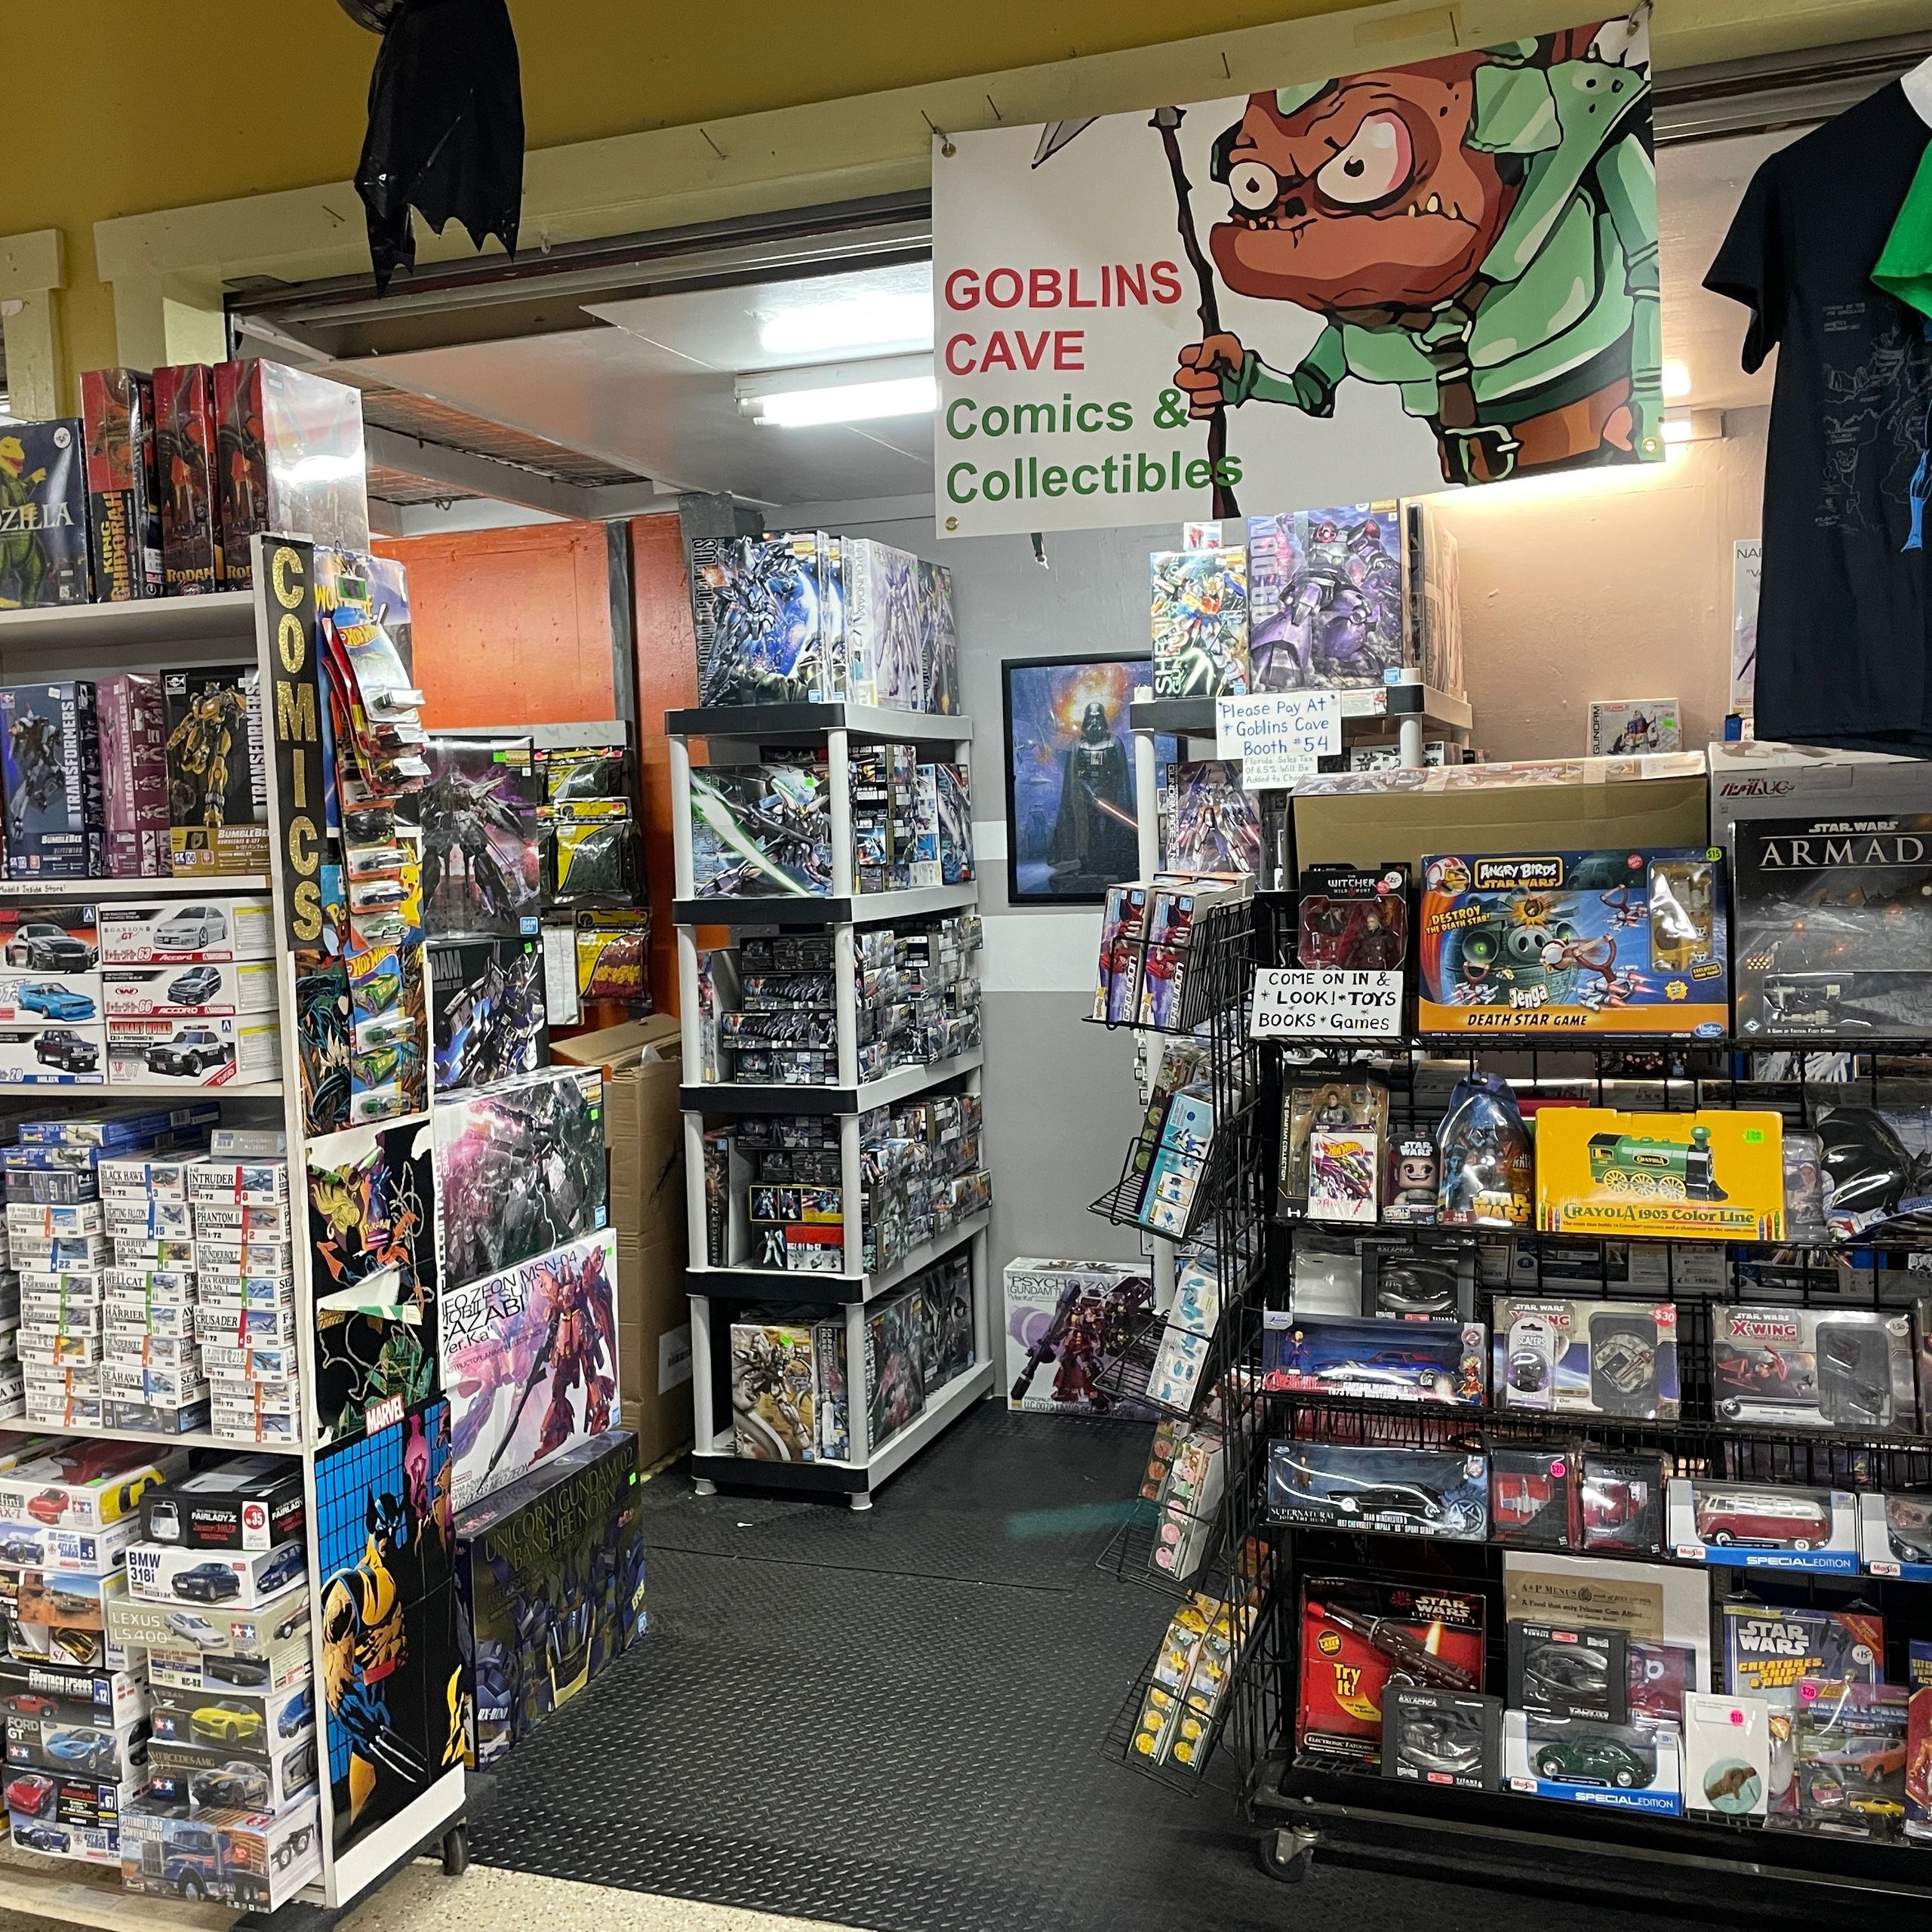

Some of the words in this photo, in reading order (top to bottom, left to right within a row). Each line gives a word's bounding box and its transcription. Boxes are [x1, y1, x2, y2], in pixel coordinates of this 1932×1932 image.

[945, 261, 1183, 310] GOBLINS
[946, 331, 1084, 375] CAVE
[946, 393, 1133, 439] Comics
[1153, 389, 1189, 429] &
[947, 451, 1244, 503] Collectibles
[102, 521, 113, 574] KING
[103, 491, 130, 601] GHIDORAH
[166, 565, 214, 583] RODAN
[1223, 703, 1269, 718] Please
[1278, 701, 1301, 716] Pay
[1307, 697, 1326, 712] At
[1237, 720, 1288, 737] Goblins
[1296, 717, 1328, 731] Cave
[246, 684, 267, 805] TRANSFORMERS
[272, 546, 322, 941] COMICS
[1244, 739, 1287, 755] Booth
[62, 701, 81, 813] TRANSFORMERS
[119, 695, 134, 810] TRANSFORMERS
[1246, 757, 1272, 765] Florida
[1247, 775, 1269, 783] Added
[1808, 823, 1853, 833] STAR
[1853, 821, 1899, 832] WARS
[42, 834, 82, 844] BUMBLEBEE
[1708, 849, 1721, 859] $15
[1481, 863, 1518, 879] ANGRY
[1520, 863, 1557, 878] BIRDS
[1327, 878, 1375, 888] WITCHER
[1481, 879, 1514, 888] STAR
[1517, 878, 1557, 888] WARS
[1431, 905, 1481, 926] DESTROY
[1426, 926, 1440, 935] THE
[1441, 920, 1466, 931] DEATH
[1468, 913, 1491, 925] STAR!
[122, 932, 133, 940] GT
[137, 947, 152, 960] 63
[353, 955, 371, 977] HOT
[1269, 973, 1315, 985] COME
[1323, 973, 1344, 984] ON
[1352, 973, 1368, 985] IN
[1377, 972, 1391, 986] &
[1123, 955, 1137, 1021] GROUDON
[1169, 962, 1185, 1028] GROUDON
[1277, 991, 1335, 1005] LOOK!
[1348, 992, 1396, 1006] TOYS
[1511, 985, 1548, 1008] Jenga
[139, 999, 152, 1012] 66
[1259, 1013, 1315, 1027] BOOKS
[1331, 1014, 1389, 1029] Games
[1468, 1014, 1512, 1026] DEATH
[1514, 1014, 1549, 1026] STAR
[1554, 1015, 1588, 1026] GAME
[146, 1021, 172, 1035] WORKS
[10, 1069, 23, 1081] 20
[125, 1063, 138, 1077] 07
[1329, 1145, 1340, 1155] HOT
[1400, 1146, 1433, 1156] WARS
[1404, 1141, 1432, 1150] STAR
[1637, 1156, 1664, 1164] CRAYOLA
[101, 1171, 122, 1180] BLACK
[124, 1171, 144, 1182] HAWK
[189, 1174, 234, 1184] INTRUDER
[1473, 1191, 1531, 1208] STAR
[106, 1209, 127, 1218] FIGHTING
[128, 1209, 146, 1218] FALCON
[197, 1212, 233, 1223] PHANTOM
[1473, 1204, 1532, 1222] WARS
[1564, 1202, 1636, 1221] CRAYOLA
[1638, 1208, 1669, 1220] 1903
[1672, 1210, 1717, 1221] Color
[1720, 1211, 1755, 1223] Line
[249, 1231, 255, 1239] 2
[59, 1260, 70, 1269] 22
[106, 1275, 143, 1287] HELLCAT
[213, 1277, 241, 1285] HARRIER
[470, 1273, 515, 1300] ZEON
[520, 1250, 578, 1281] MSN-04
[106, 1308, 144, 1320] HARRIER
[196, 1314, 238, 1327] CRUSADER
[1655, 1310, 1675, 1322] $30
[1763, 1313, 1789, 1321] WARS
[1730, 1320, 1797, 1337] X-WING
[246, 1335, 252, 1343] 9
[102, 1371, 143, 1385] SEAHAWK
[367, 1399, 404, 1430] MARVEL
[1552, 1465, 1564, 1475] $20
[485, 1497, 555, 1562] UNICORN
[558, 1459, 618, 1513] GUNDAM
[620, 1447, 634, 1472] 02
[191, 1512, 228, 1522] FAIRLADY
[228, 1515, 237, 1523] Z
[1271, 1507, 1334, 1520] SUPERNATURAL
[514, 1512, 574, 1572] BANSHEE
[578, 1488, 616, 1527] NORN
[129, 1552, 161, 1566] BMW
[1679, 1547, 1703, 1558] Maisto
[1746, 1556, 1814, 1567] SPECIAL
[1814, 1558, 1850, 1568] EDITION
[131, 1567, 155, 1583] 318i
[1873, 1564, 1898, 1574] Maisto
[1546, 1586, 1577, 1597] MENUS
[1416, 1595, 1470, 1610] STAR
[1417, 1604, 1470, 1617] WARS
[112, 1611, 161, 1627] LEXUS
[115, 1629, 168, 1644] LS400
[1739, 1621, 1810, 1641] STAR
[1319, 1638, 1340, 1649] LASER
[1739, 1635, 1810, 1656] WARS
[1334, 1663, 1361, 1684] Try
[1760, 1666, 1806, 1678] SHIPS
[29, 1672, 65, 1686] COUNTACH
[66, 1678, 93, 1689] LP500S
[1337, 1679, 1356, 1697] It!
[1802, 1687, 1815, 1697] $20
[1398, 1697, 1438, 1707] GALACTICA
[7, 1715, 38, 1730] FORD
[1730, 1713, 1743, 1724] $10
[8, 1727, 24, 1740] GT
[1308, 1737, 1344, 1747] ELECTRONIC
[151, 1751, 215, 1767] MERCEDES-AMG
[1512, 1780, 1535, 1791] Maisto
[1575, 1792, 1638, 1806] SPECIAL
[1638, 1797, 1674, 1810] EDITION
